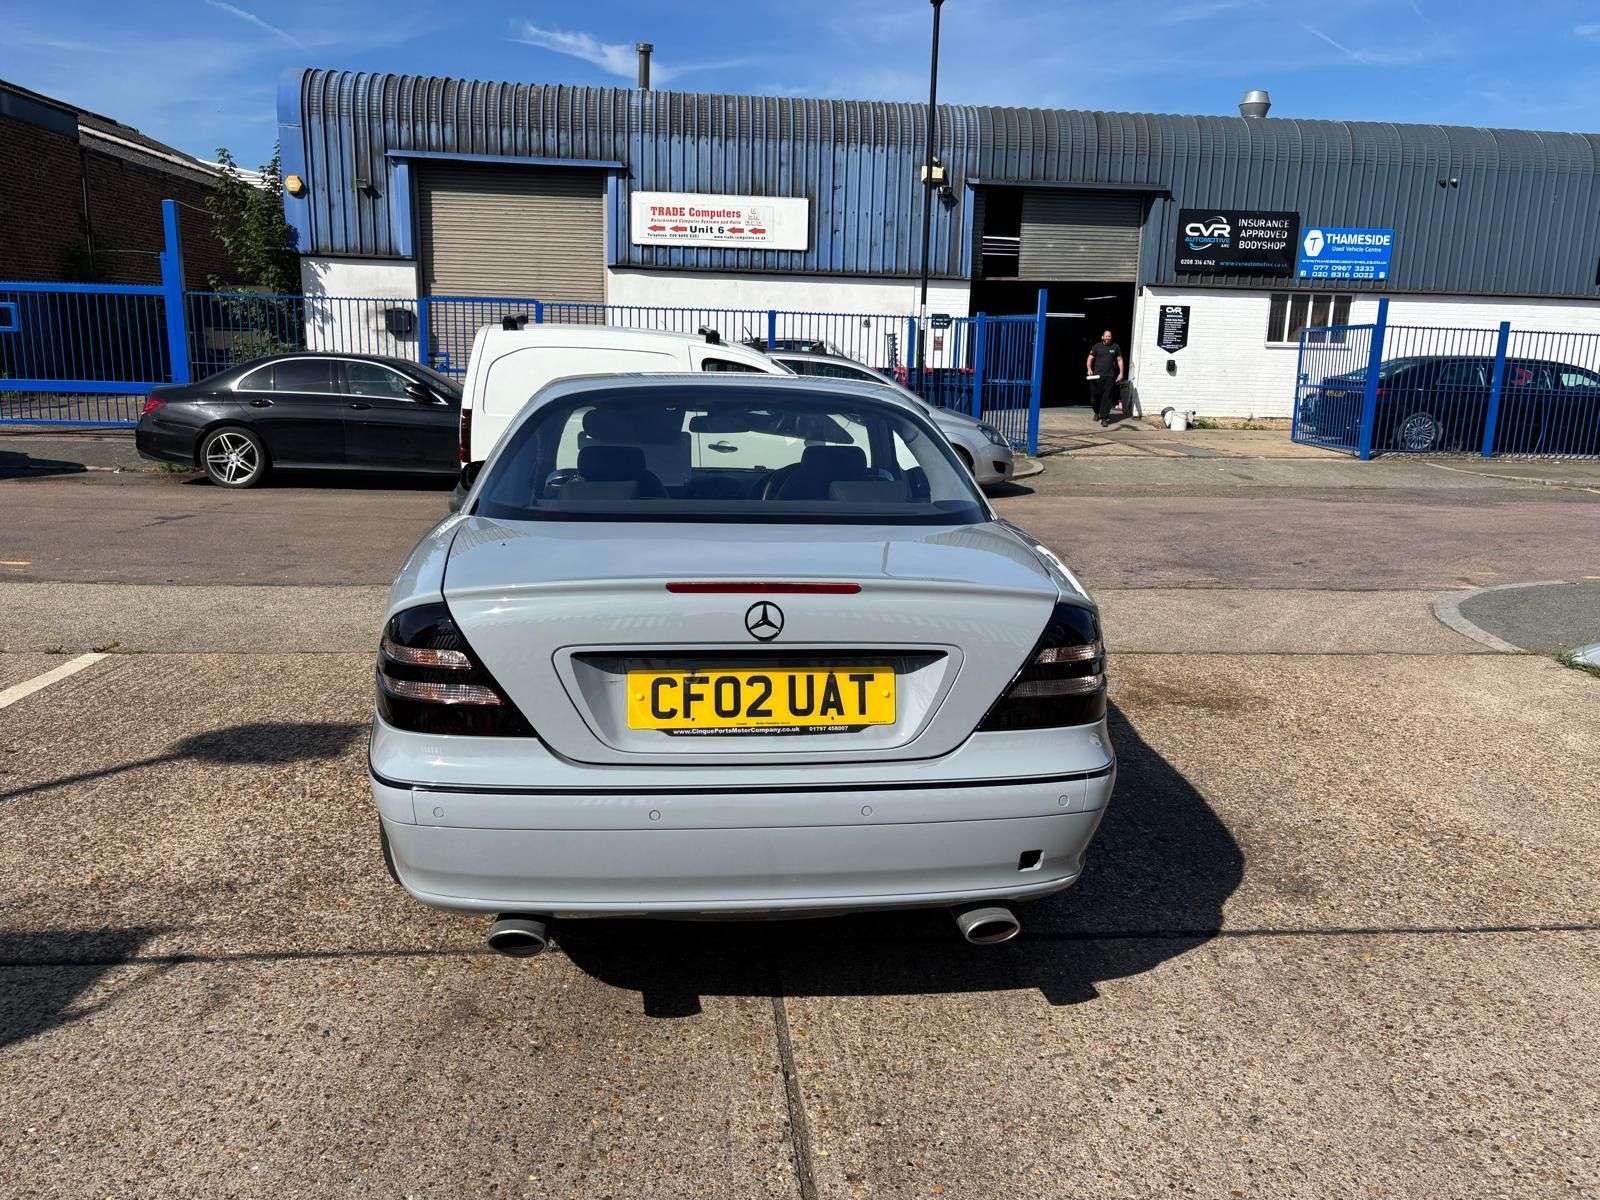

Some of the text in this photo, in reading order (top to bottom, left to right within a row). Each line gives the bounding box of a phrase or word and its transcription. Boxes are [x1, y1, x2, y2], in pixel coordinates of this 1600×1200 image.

[650, 206, 741, 219] TRADE Computers
[1238, 218, 1290, 229] INSURANCE
[689, 225, 725, 234] Unit 6
[1185, 223, 1231, 238] CVR
[1239, 229, 1288, 239] APPROVED
[1238, 240, 1287, 250] BODYSHOP
[1326, 233, 1391, 246] THAMESIDE
[650, 672, 875, 720] CF02 UAT
[673, 726, 800, 735] www.CinquePortsMotorCompany.co.uk
